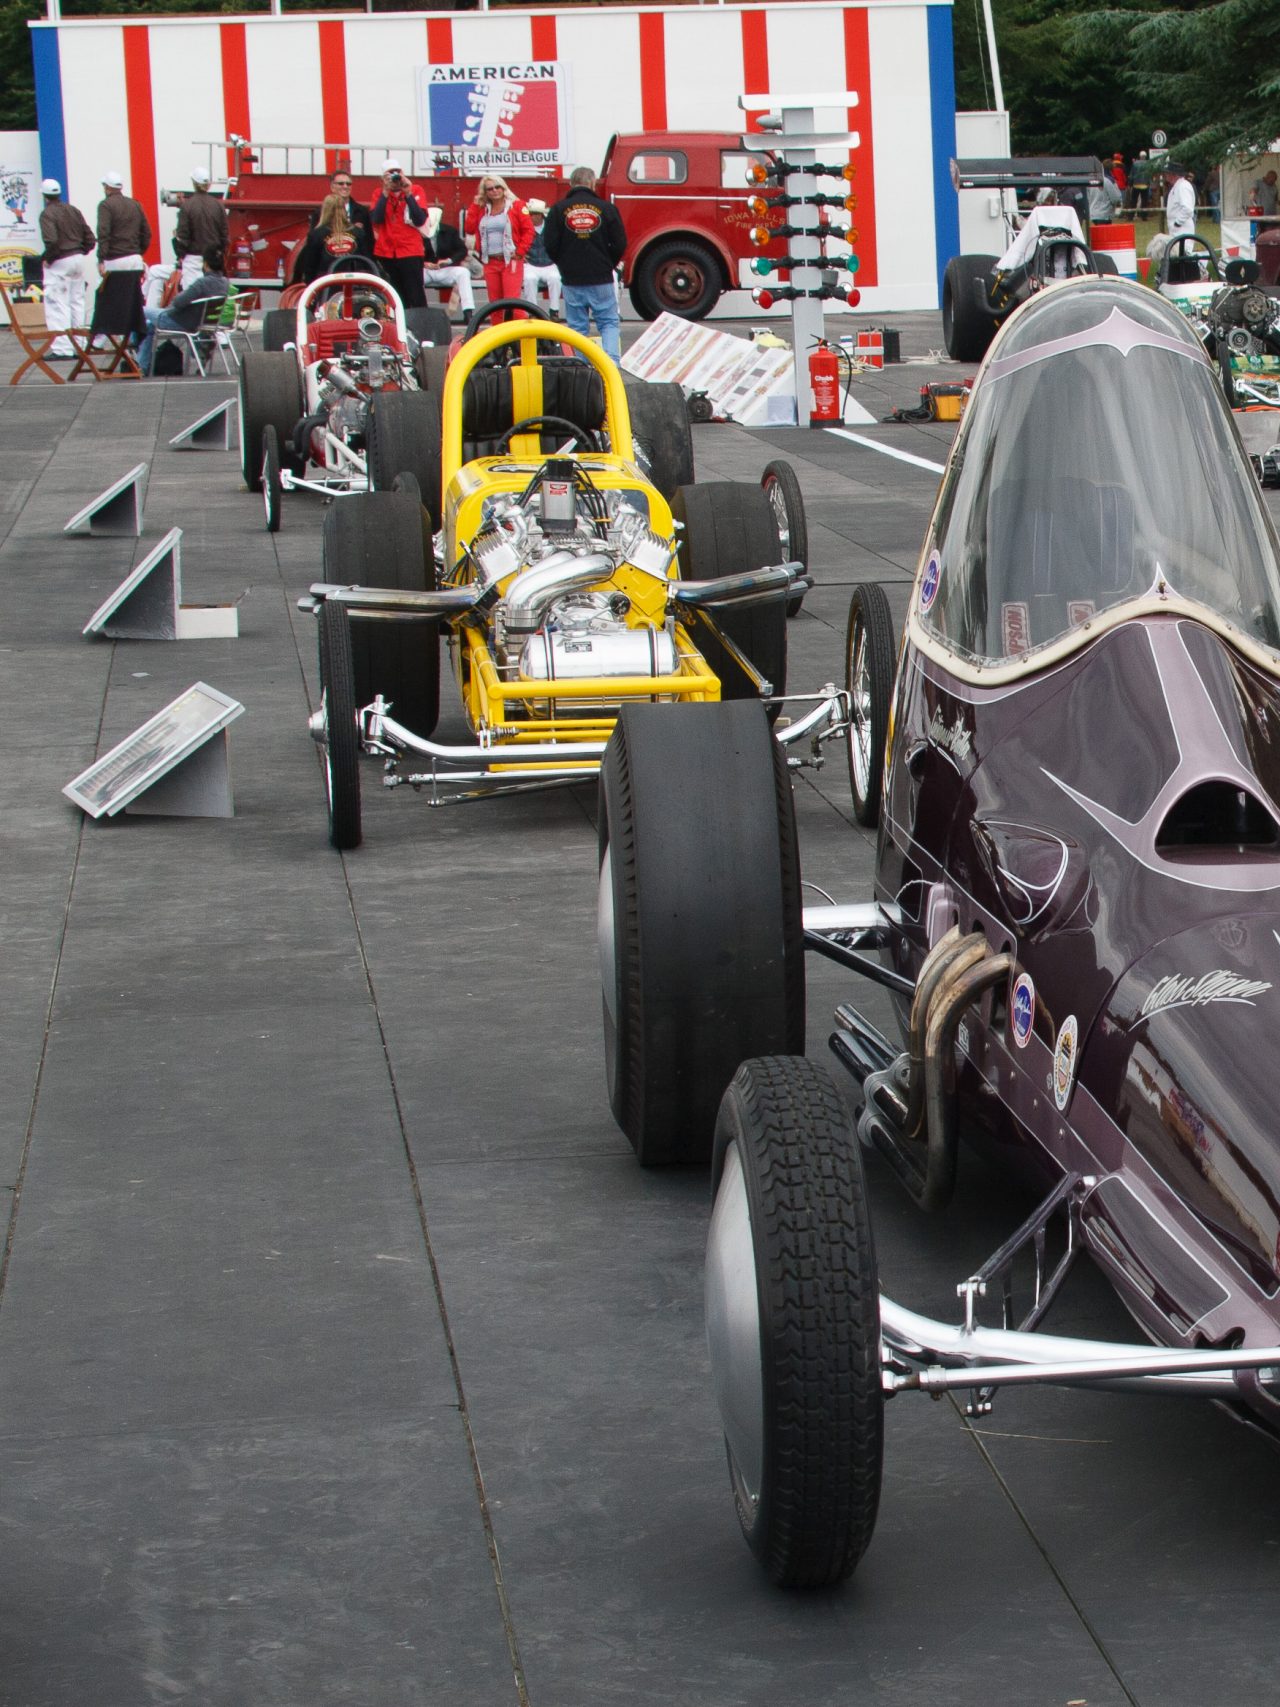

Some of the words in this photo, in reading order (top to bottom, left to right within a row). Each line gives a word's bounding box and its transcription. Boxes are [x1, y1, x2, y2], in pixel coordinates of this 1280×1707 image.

[432, 65, 555, 81] AMERICAN
[468, 153, 511, 164] RACING
[515, 152, 559, 163] LEAGUE
[723, 211, 749, 224] IOWA
